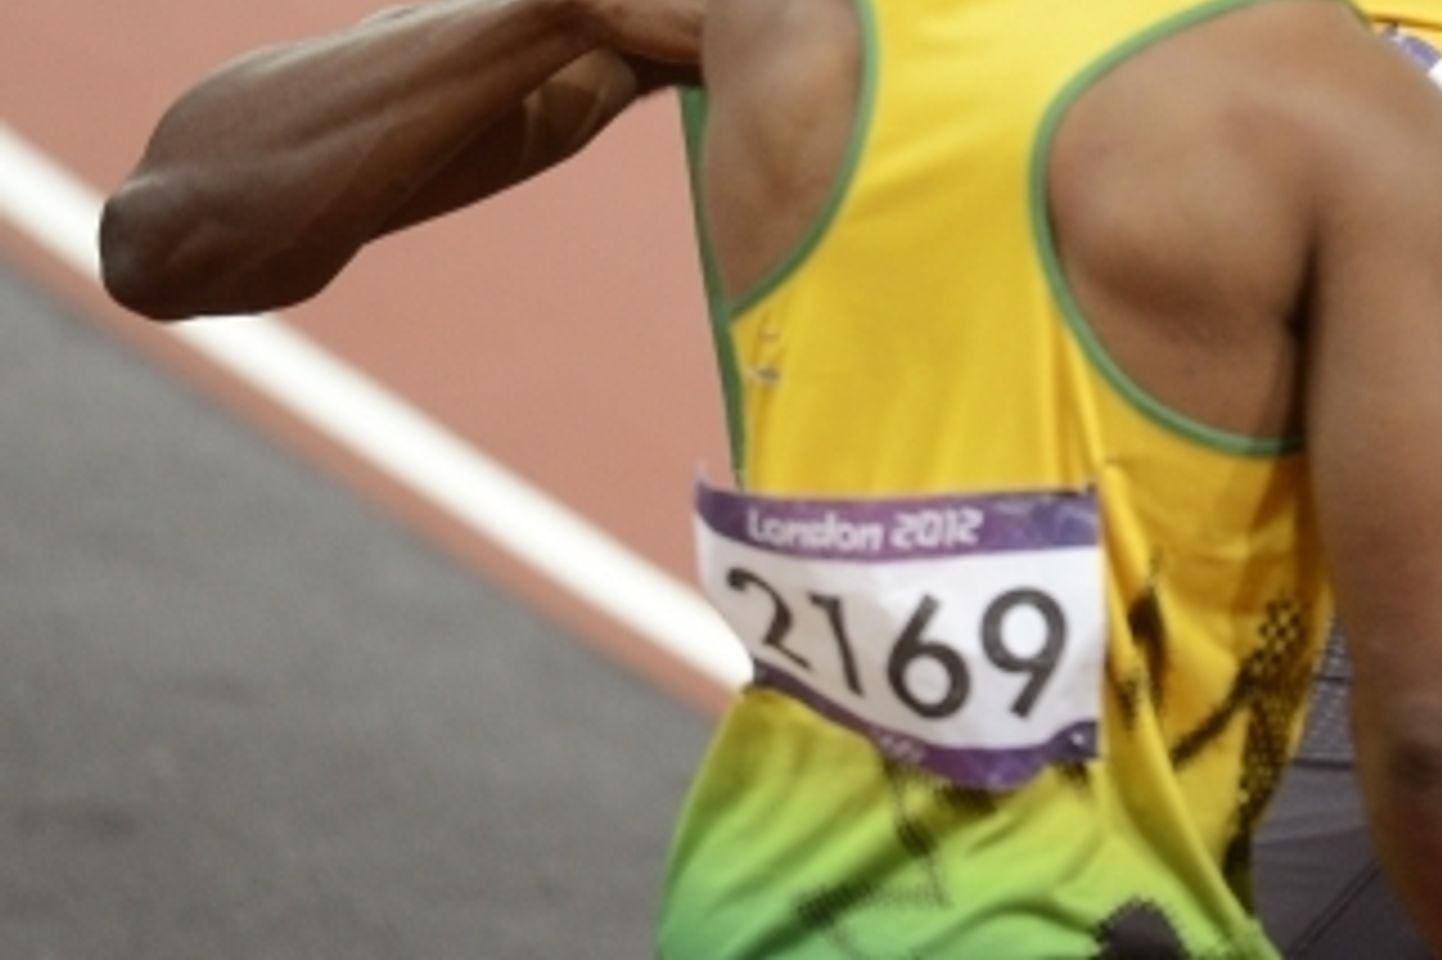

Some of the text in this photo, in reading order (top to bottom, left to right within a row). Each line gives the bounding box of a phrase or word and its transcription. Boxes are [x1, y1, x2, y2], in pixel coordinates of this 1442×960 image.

[747, 508, 984, 551] London 2012
[725, 566, 1068, 720] 2169
